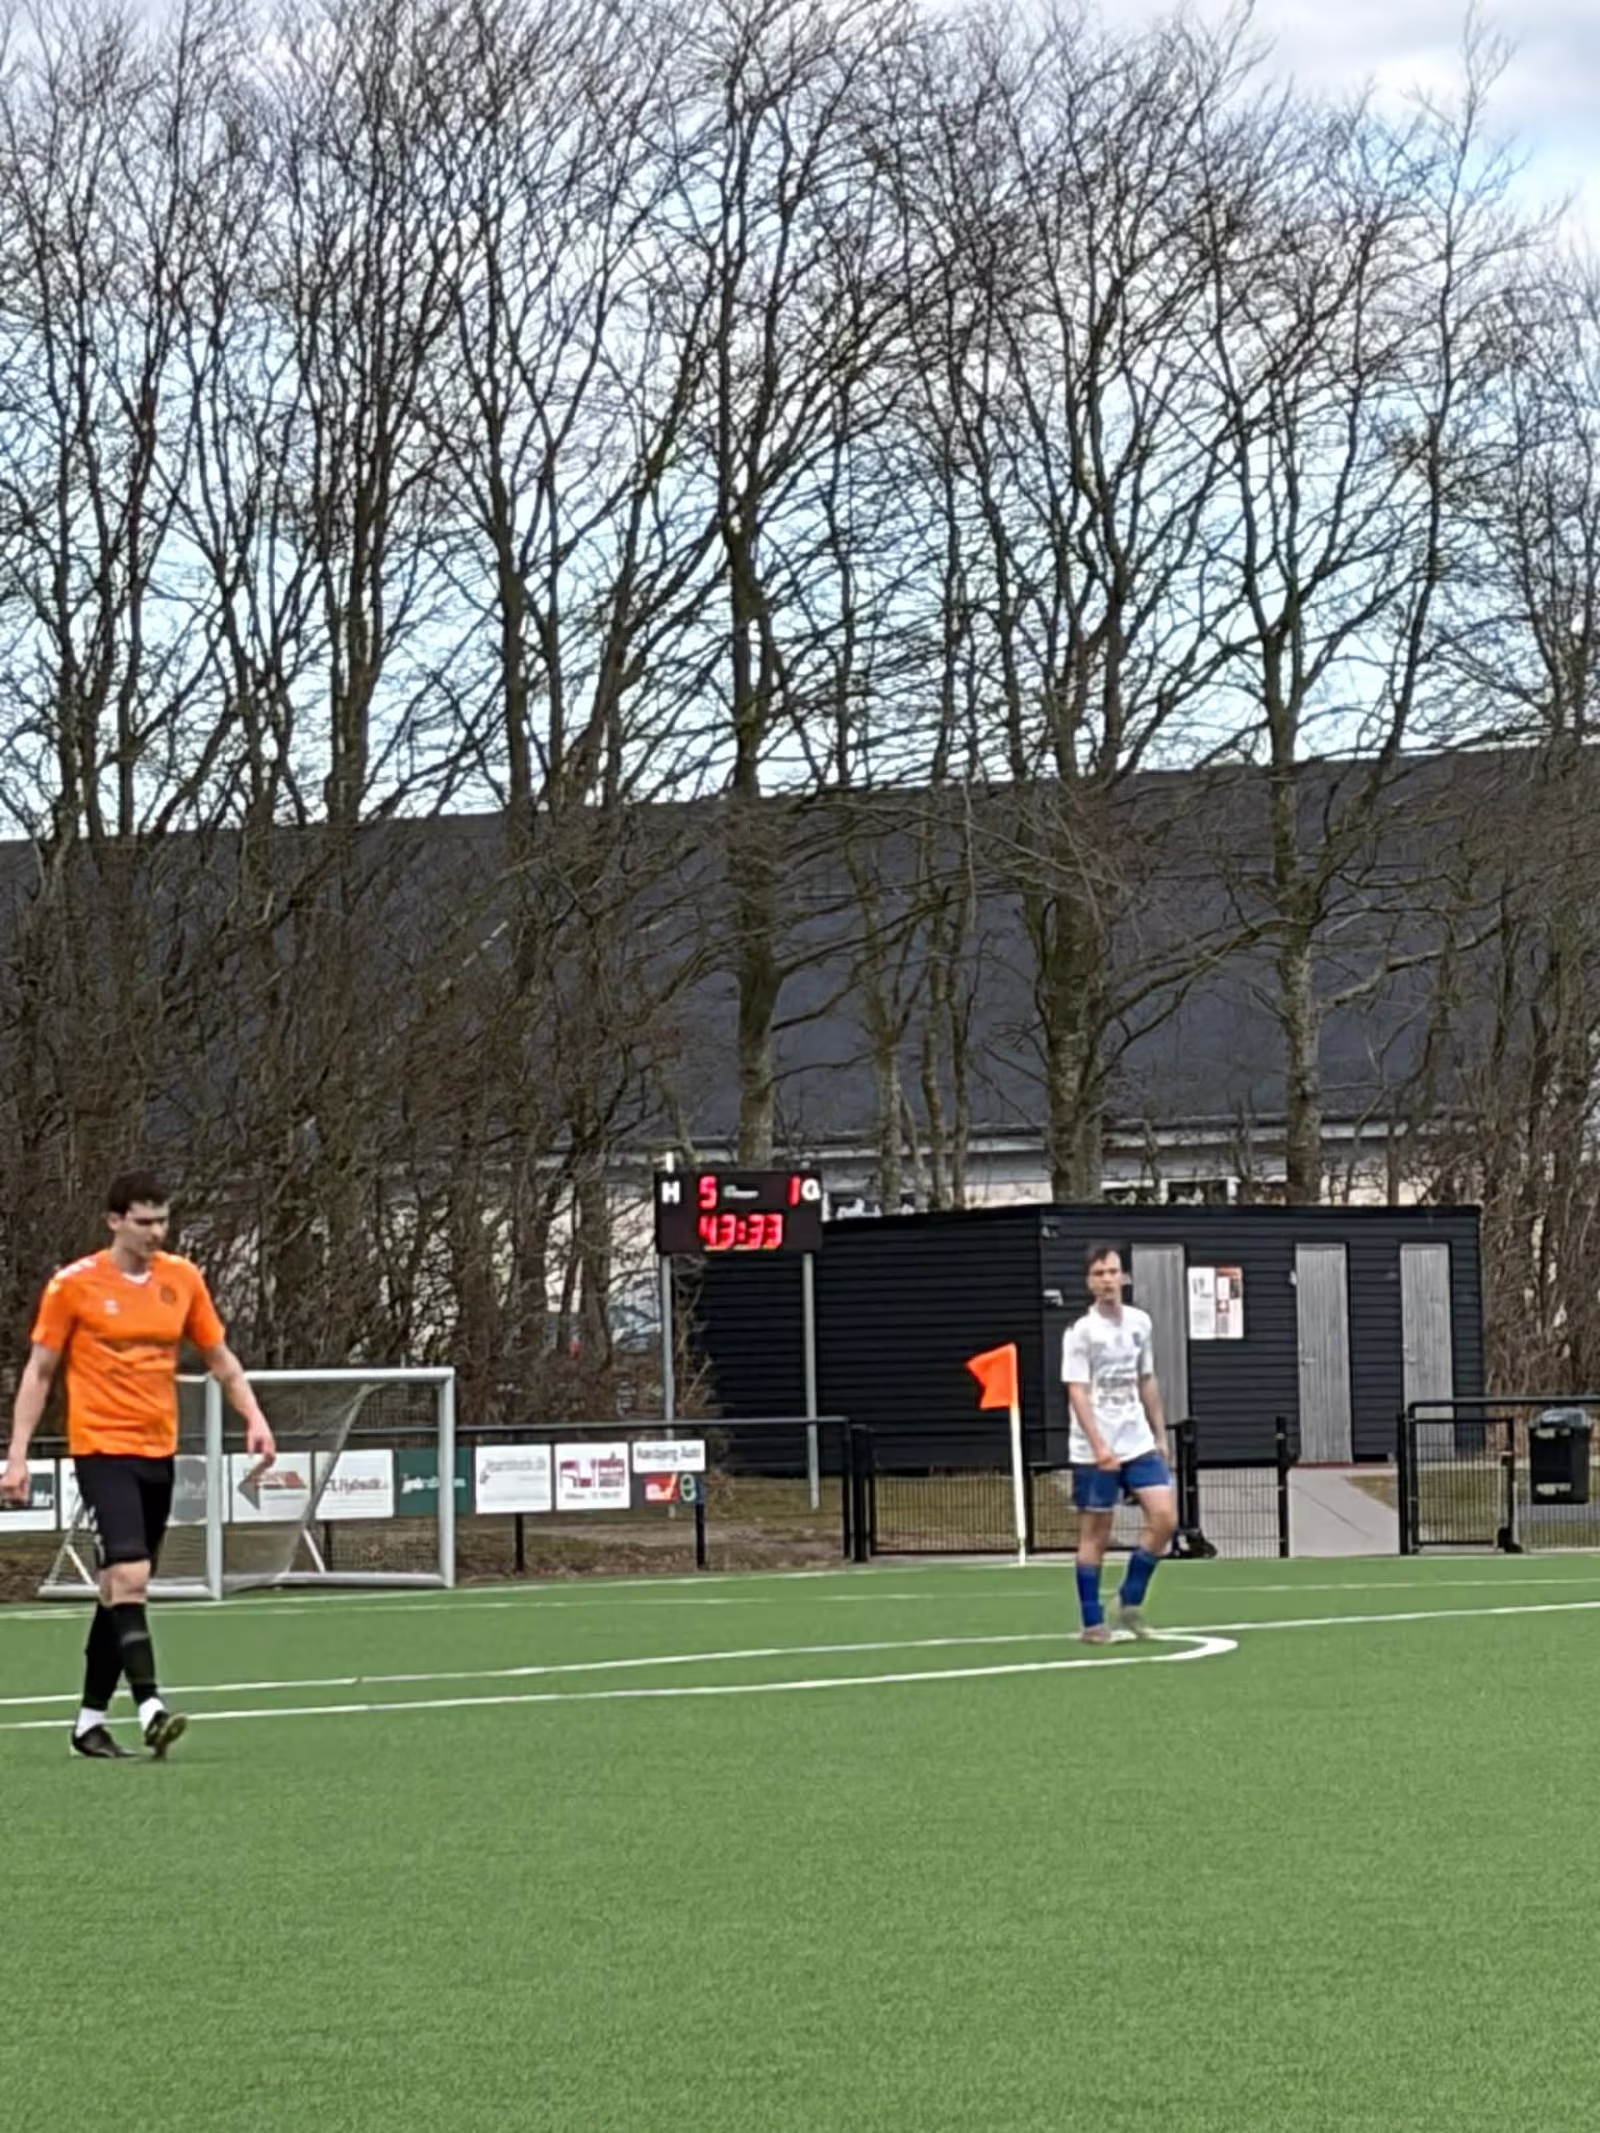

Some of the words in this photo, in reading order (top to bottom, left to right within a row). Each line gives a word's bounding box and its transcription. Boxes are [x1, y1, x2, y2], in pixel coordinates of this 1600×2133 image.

[661, 1181, 681, 1204] H
[699, 1175, 717, 1209] 5
[790, 1175, 801, 1207] 1
[698, 1213, 783, 1249] 43:33
